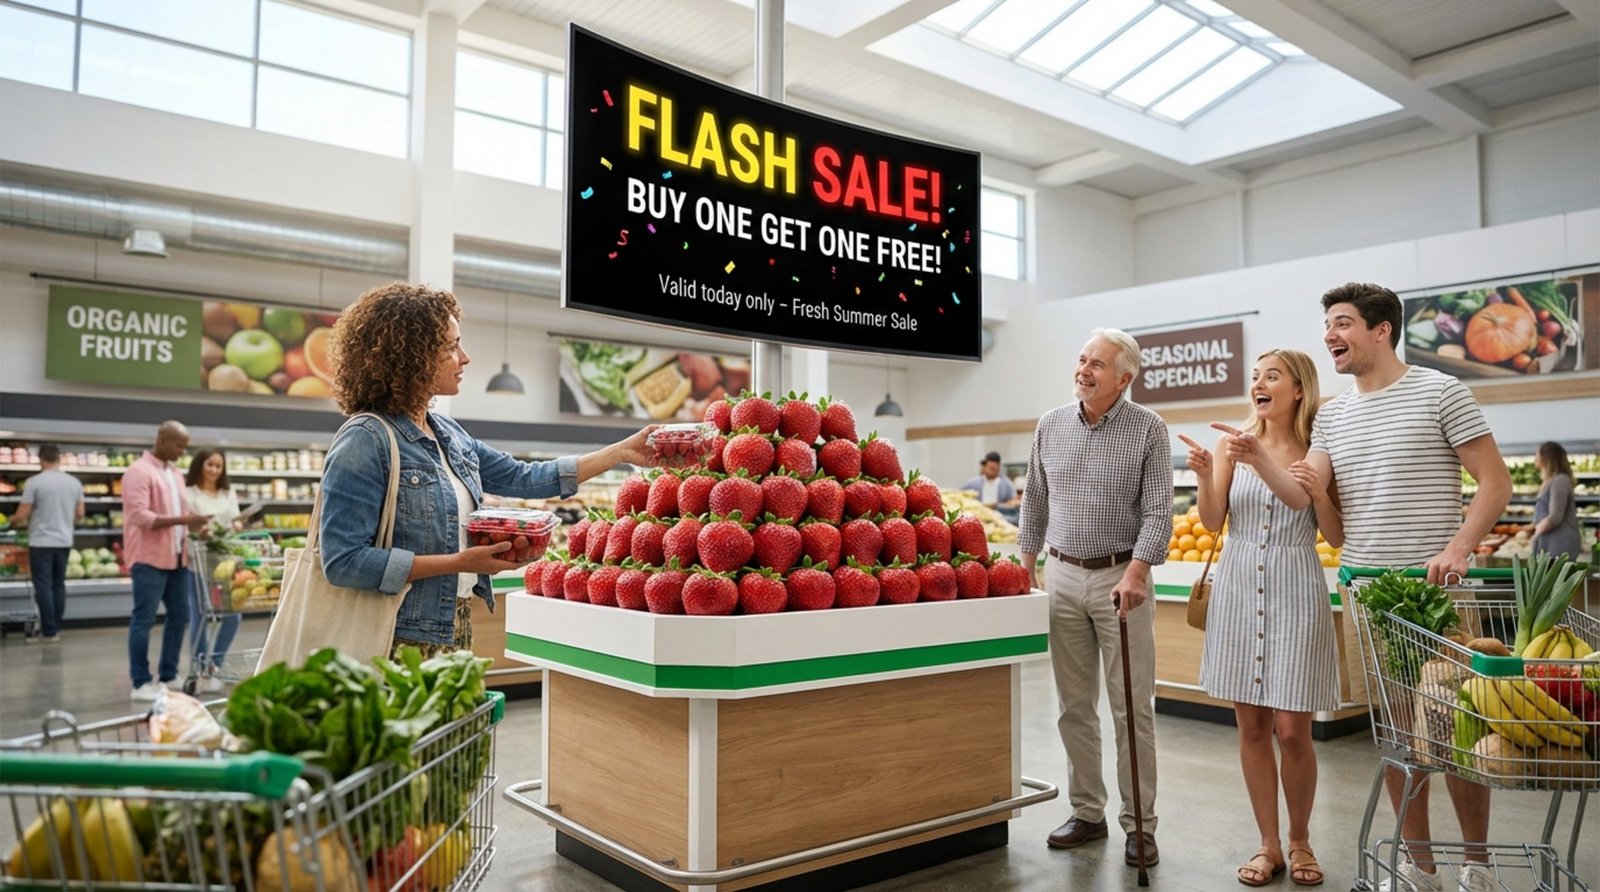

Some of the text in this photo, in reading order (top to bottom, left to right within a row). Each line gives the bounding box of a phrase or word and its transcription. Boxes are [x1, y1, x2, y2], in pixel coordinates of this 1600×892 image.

[628, 85, 940, 223] FLASH SALE!
[627, 177, 941, 274] BUY ONE GET ONE FREE!
[659, 273, 697, 300] Valid
[701, 284, 741, 311] today
[746, 292, 774, 316] only
[793, 298, 829, 320] Fresh
[834, 305, 888, 327] Summer
[891, 311, 918, 331] Sale
[67, 305, 187, 338] ORGANIC
[80, 334, 173, 363] FRUITS
[1140, 339, 1233, 367] SEASONAL
[1144, 362, 1228, 390] SPECIALS
